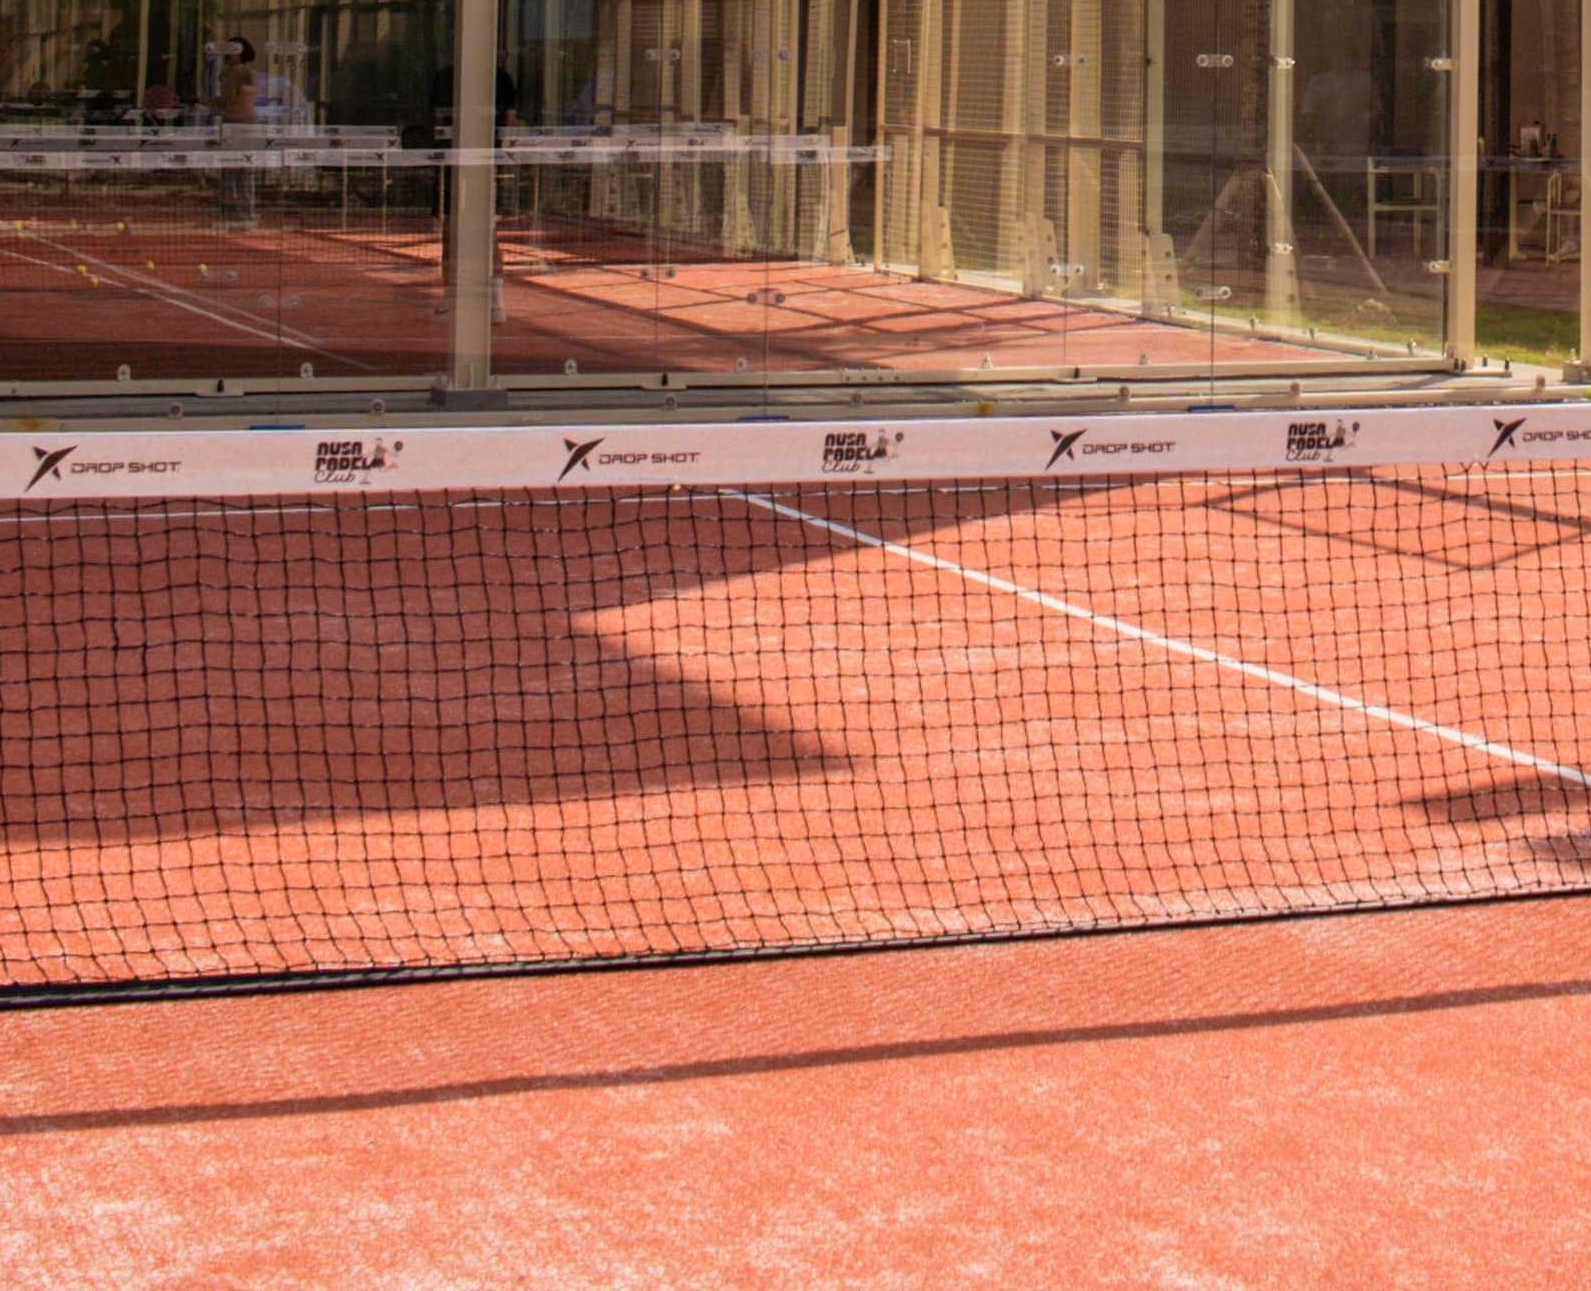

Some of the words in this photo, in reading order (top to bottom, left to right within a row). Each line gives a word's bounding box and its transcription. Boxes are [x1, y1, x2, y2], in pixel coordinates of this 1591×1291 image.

[1288, 423, 1326, 436] NUSA
[825, 433, 866, 447] NUSA
[1287, 436, 1333, 450] PADEL
[1523, 431, 1563, 442] DROP
[317, 441, 362, 456] NUSA
[823, 447, 874, 461] PADEL
[1082, 443, 1128, 454] DROP
[1131, 442, 1176, 453] SHOT
[315, 457, 371, 471] PADEL
[599, 453, 648, 464] DROP
[651, 452, 701, 463] SHOT
[71, 462, 125, 474] DROP
[128, 461, 182, 473] SHOT
[822, 460, 860, 473] Club
[315, 470, 355, 483] Club
